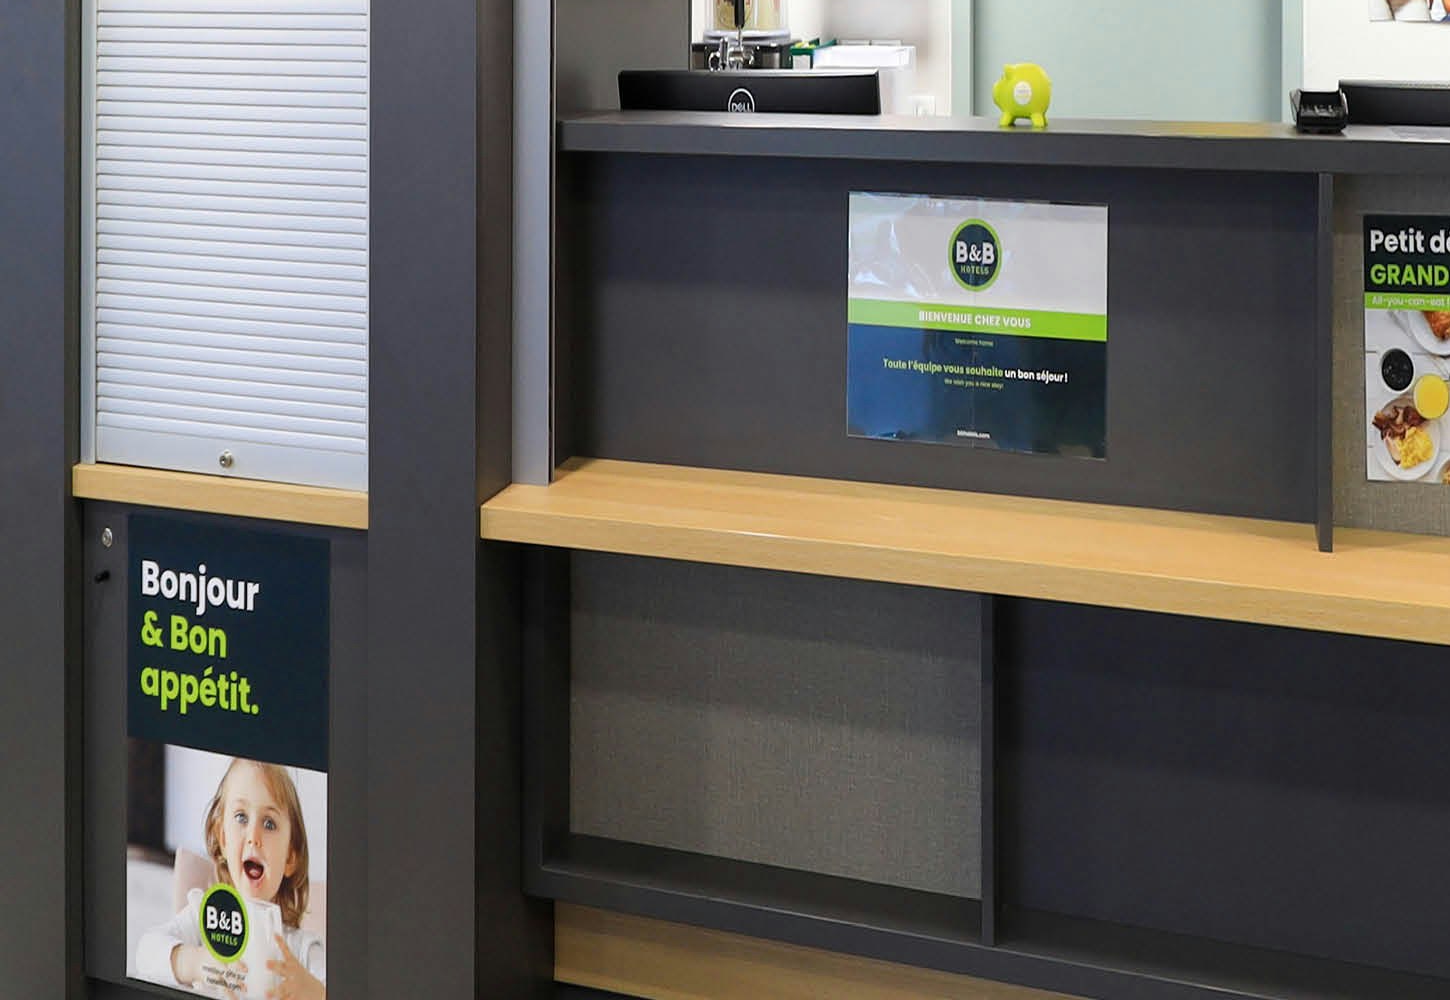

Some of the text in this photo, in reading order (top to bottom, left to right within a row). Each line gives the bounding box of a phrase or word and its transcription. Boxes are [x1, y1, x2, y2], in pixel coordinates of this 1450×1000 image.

[955, 240, 995, 265] B&B
[1370, 227, 1425, 253] Petit
[960, 264, 990, 275] HOTELS
[1370, 264, 1450, 287] GRAND
[918, 311, 1032, 329] BIENVENUE CHEZ VOUS
[882, 358, 907, 369] Toute
[908, 359, 942, 375] l'équipe
[943, 364, 965, 374] vous
[965, 365, 1004, 377] souhaite
[1005, 369, 1017, 379] un
[1018, 369, 1035, 380] bon
[141, 559, 260, 616] Bonjour
[141, 610, 227, 658] & Bon
[140, 666, 260, 715] appétit.
[206, 904, 243, 935] B&B
[210, 932, 238, 947] HOTELS
